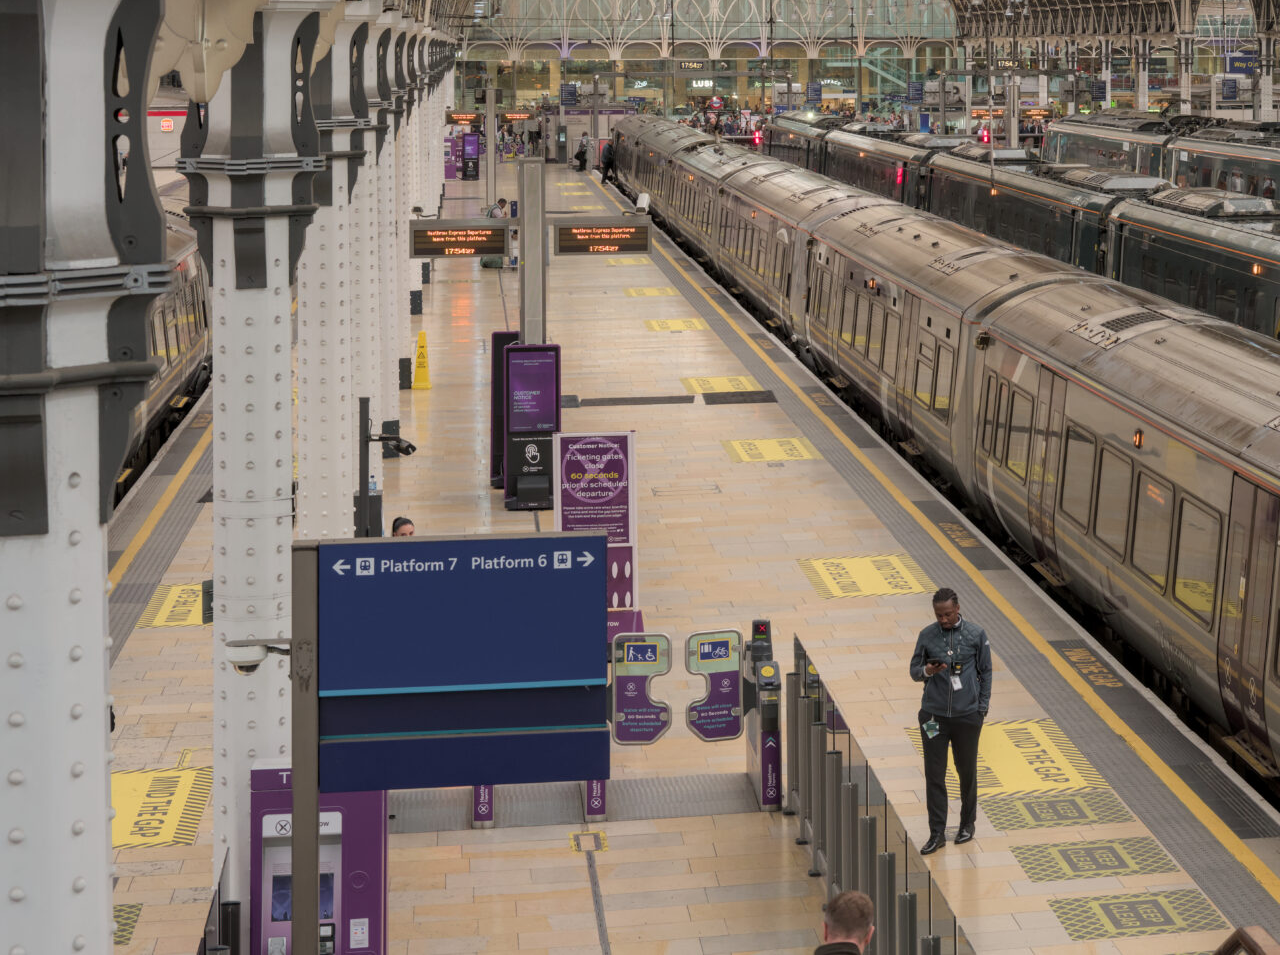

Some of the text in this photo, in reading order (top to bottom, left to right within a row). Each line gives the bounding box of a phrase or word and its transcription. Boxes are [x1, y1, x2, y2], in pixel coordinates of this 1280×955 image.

[567, 453, 623, 462] Ticketing gates
[584, 471, 619, 479] seconds
[562, 481, 580, 489] prior
[589, 480, 628, 488] scheduled
[576, 489, 614, 498] departure
[380, 557, 458, 573] Platform 7
[471, 554, 547, 570] Platform 6
[880, 570, 905, 581] THE
[888, 580, 913, 590] GAP
[1075, 662, 1110, 674] THE
[1088, 674, 1124, 687] GAP
[1002, 728, 1070, 783] MIND THE GAP
[129, 775, 182, 837] MIND THE GAP
[1031, 802, 1057, 821] CLEAR
[1055, 802, 1080, 817] KEEP
[1067, 849, 1096, 871] CLEAR
[1092, 849, 1119, 866] KEEP
[1109, 904, 1140, 928] CLEAR
[1135, 903, 1164, 923] KEEP
